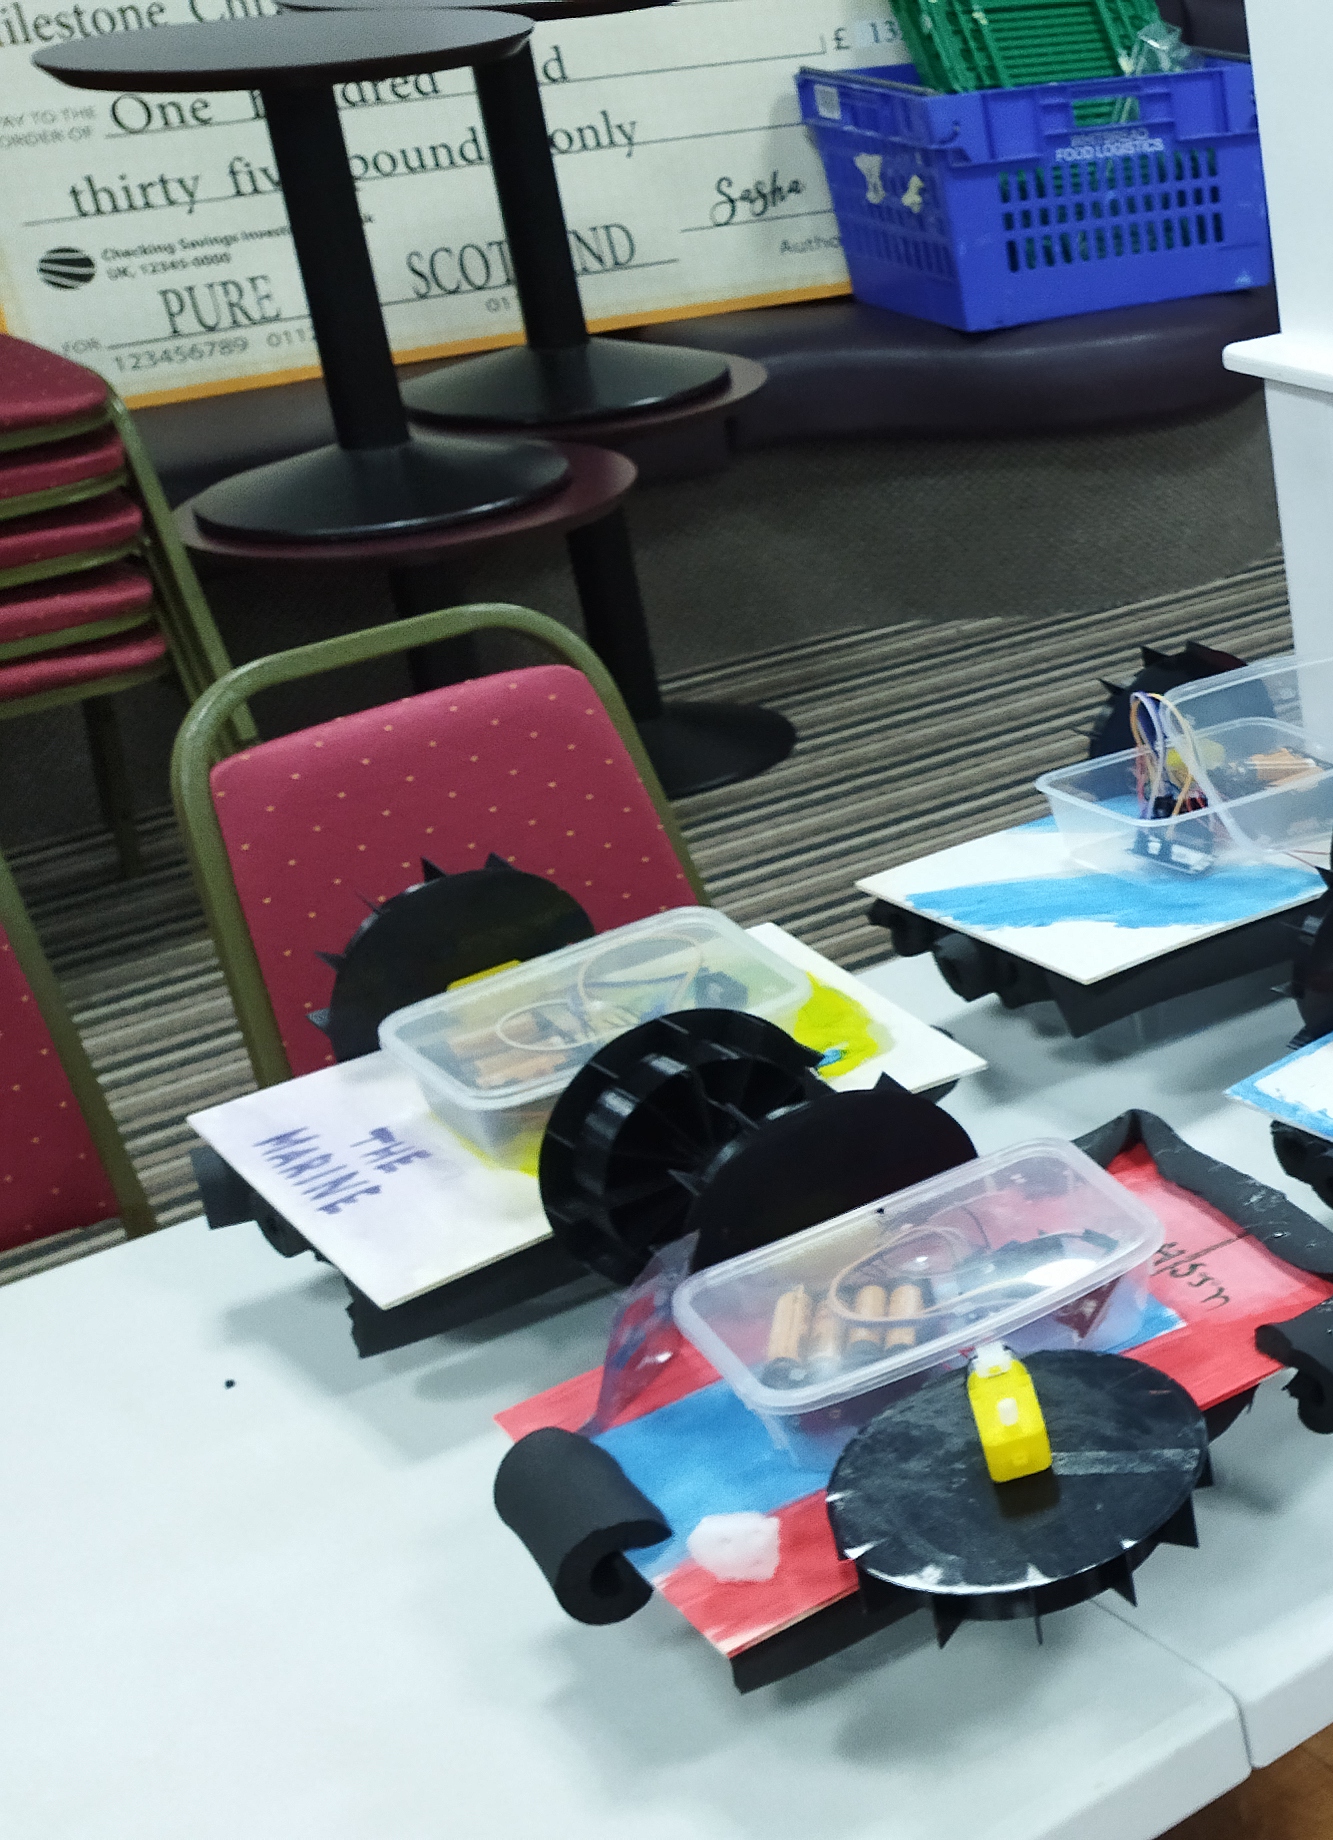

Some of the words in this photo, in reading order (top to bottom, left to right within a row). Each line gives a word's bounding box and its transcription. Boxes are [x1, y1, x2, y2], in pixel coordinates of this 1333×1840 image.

[0, 2, 165, 47] ilestone
[111, 94, 213, 134] One
[69, 173, 200, 217] thirty
[228, 156, 282, 198] fiv
[549, 110, 638, 160] only
[1055, 146, 1095, 162] FOOD
[1095, 138, 1165, 158] LOGISTICS
[102, 243, 176, 261] Checking
[178, 228, 239, 252] Savings
[158, 274, 282, 337] PURE
[406, 224, 635, 299] SCOTND
[114, 335, 249, 372] 123456789
[253, 1126, 382, 1214] MARINE
[350, 1126, 432, 1173] THE
